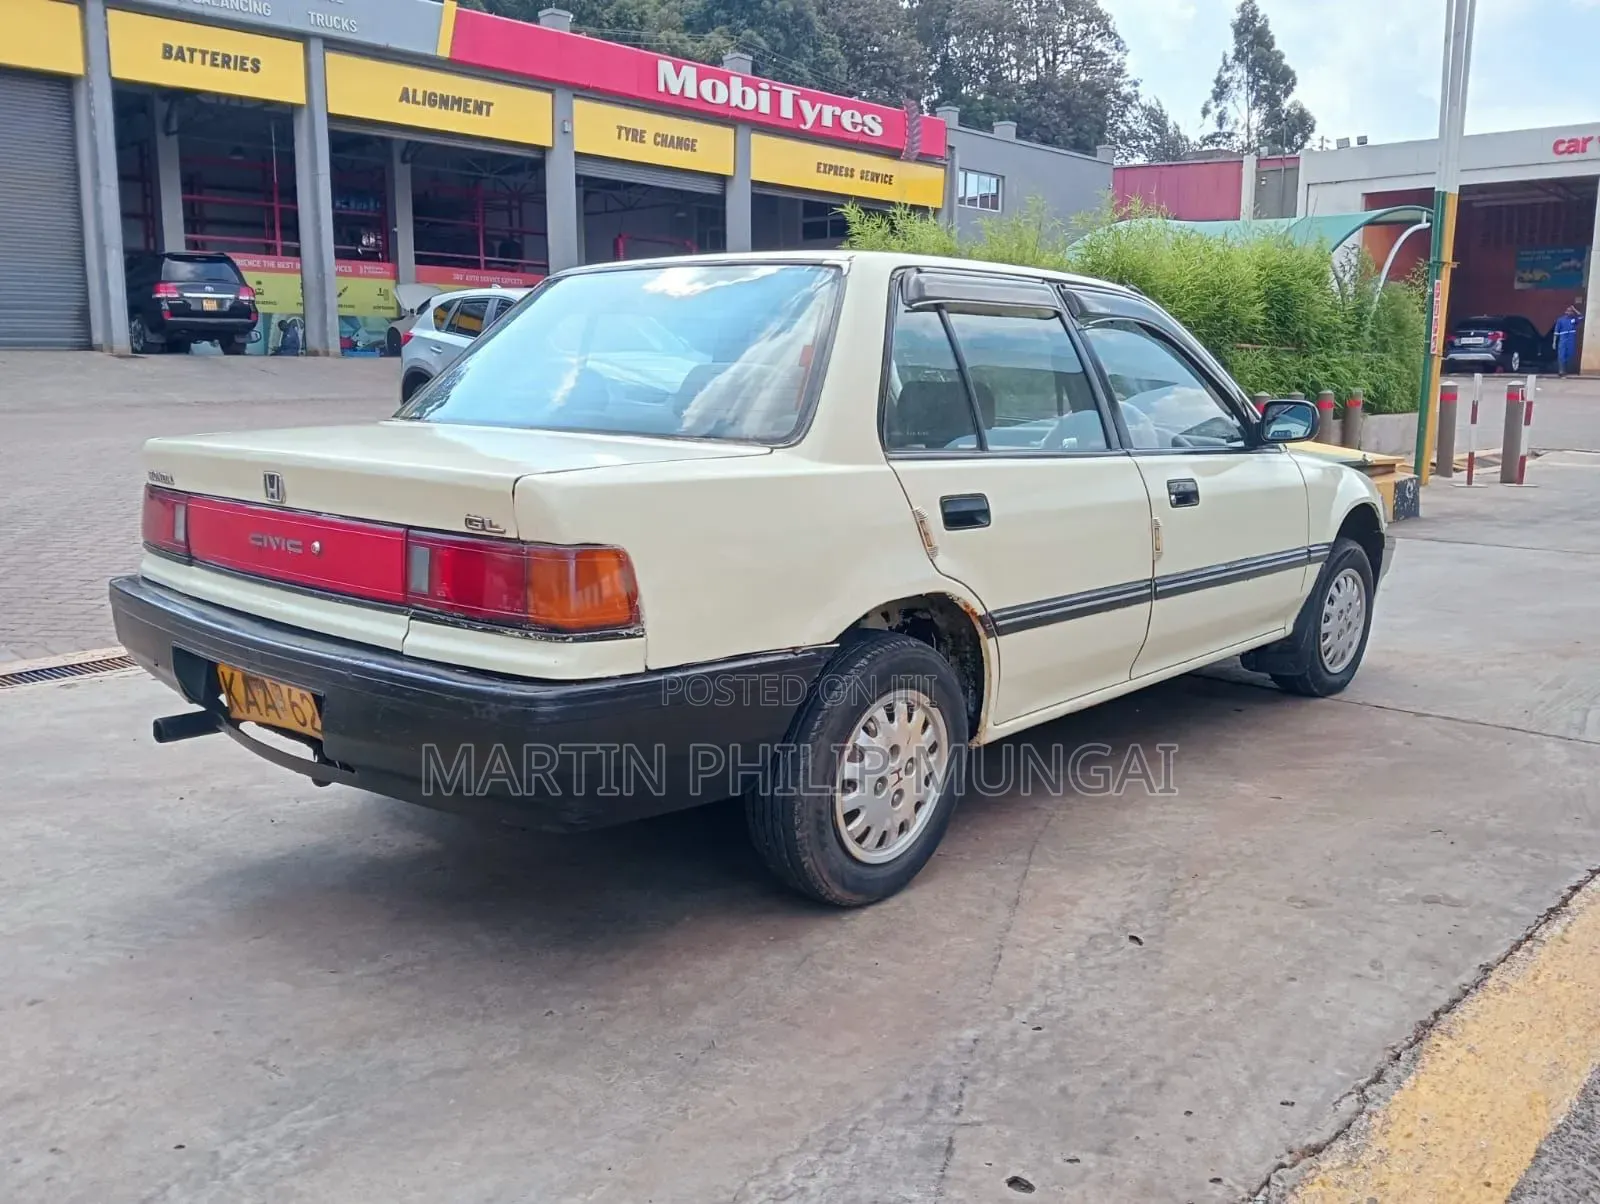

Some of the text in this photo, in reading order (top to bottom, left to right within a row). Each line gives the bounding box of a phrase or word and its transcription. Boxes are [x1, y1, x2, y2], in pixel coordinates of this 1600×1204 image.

[308, 11, 358, 33] TRUCKS
[162, 43, 262, 74] BATTERIES
[398, 86, 494, 117] ALIGNMENT
[657, 59, 883, 137] MobiTyres
[616, 125, 698, 153] TYRE CHANGE
[1552, 135, 1594, 156] car
[816, 161, 894, 185] EXPRESS SERVICE
[464, 513, 506, 535] GL
[249, 532, 303, 554] CIVIC
